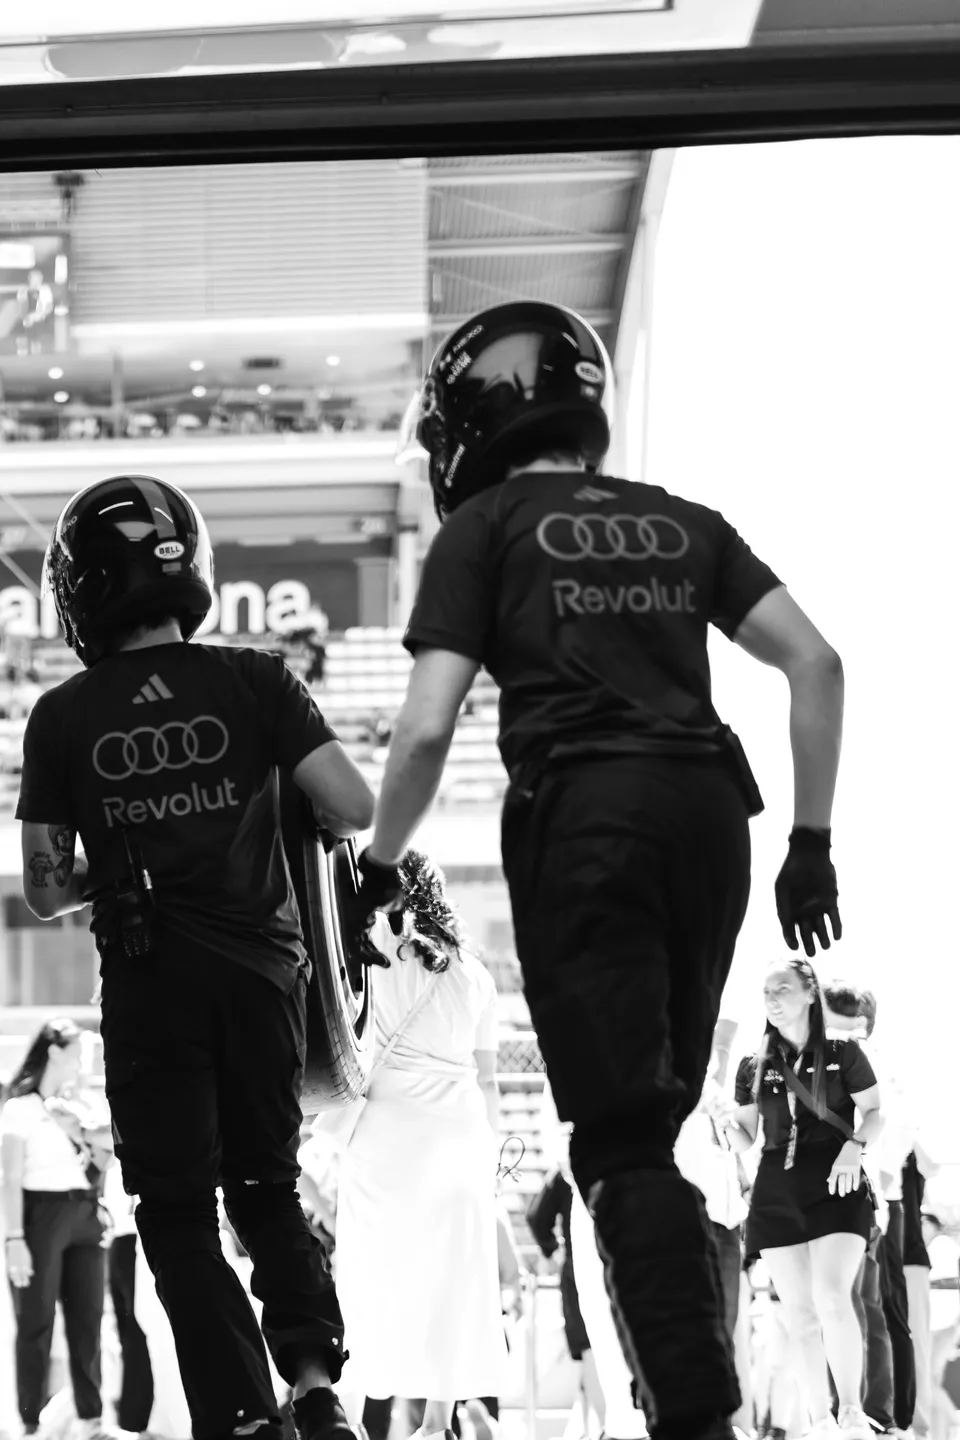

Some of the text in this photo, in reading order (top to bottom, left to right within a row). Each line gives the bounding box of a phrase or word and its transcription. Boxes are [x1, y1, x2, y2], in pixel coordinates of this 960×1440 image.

[158, 545, 180, 555] BELL
[552, 576, 696, 617] Revolut
[103, 778, 239, 827] Revolut
